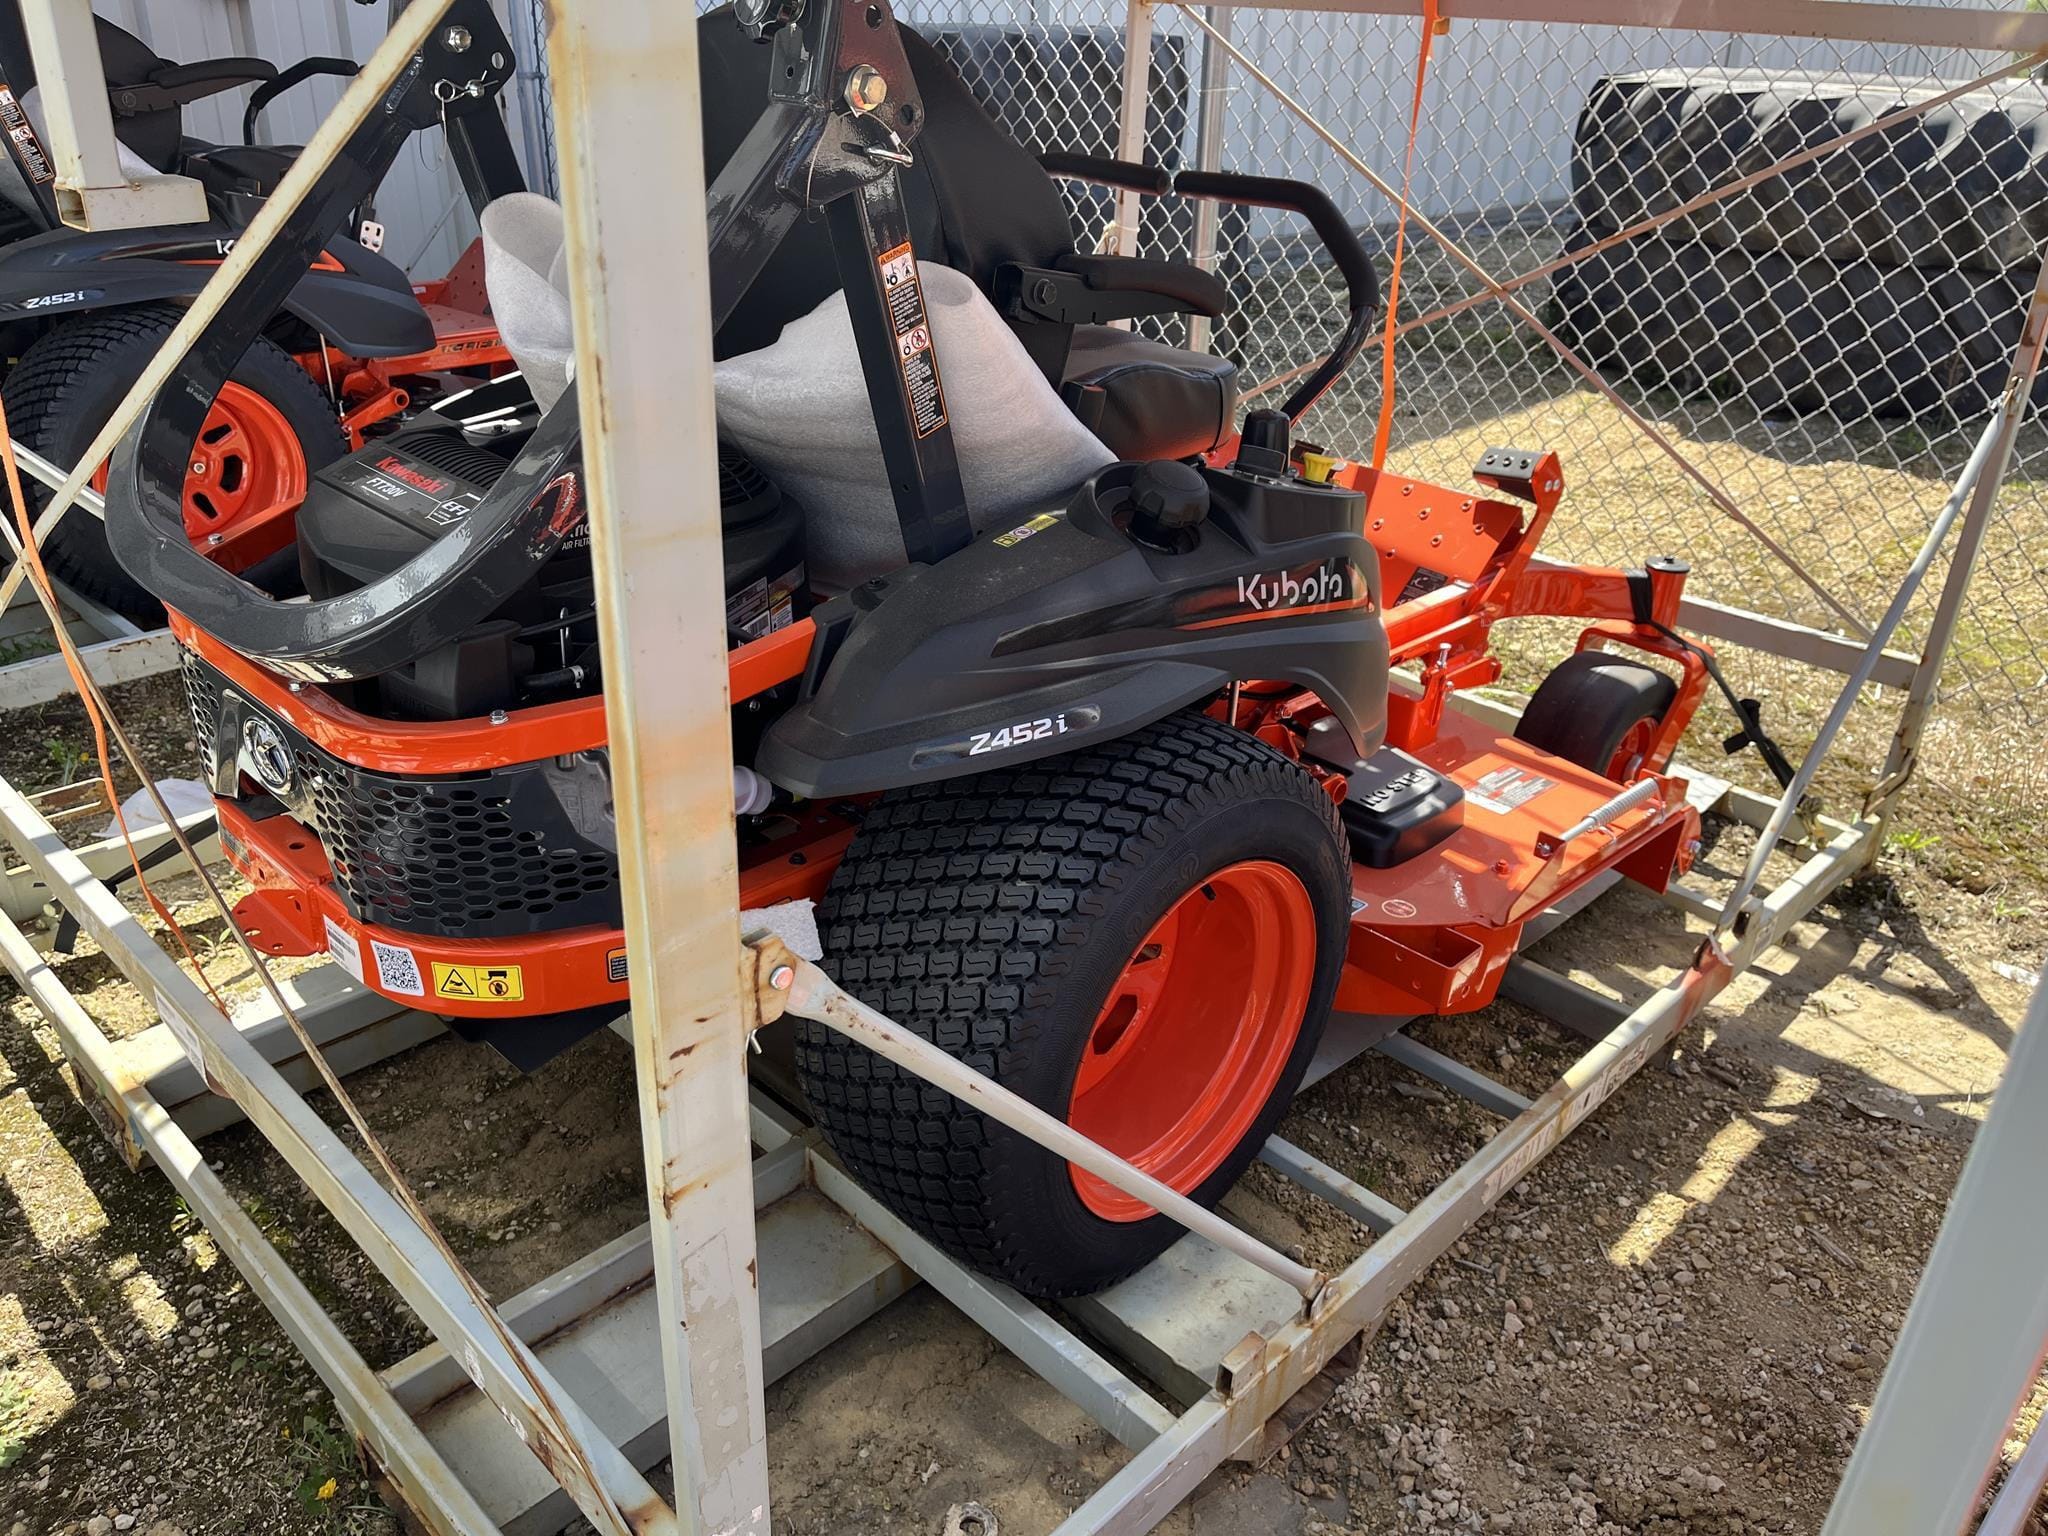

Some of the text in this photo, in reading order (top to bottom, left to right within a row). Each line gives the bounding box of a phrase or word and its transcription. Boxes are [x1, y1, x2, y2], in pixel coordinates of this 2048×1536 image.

[26, 290, 85, 309] Z452i
[375, 456, 449, 494] Kawasaki
[366, 477, 408, 497] FT730V
[441, 501, 470, 516] EFI
[562, 537, 592, 551] AIR FILTR
[1237, 565, 1343, 610] Kubota
[968, 713, 1069, 756] Z452i
[1359, 788, 1390, 807] NO
